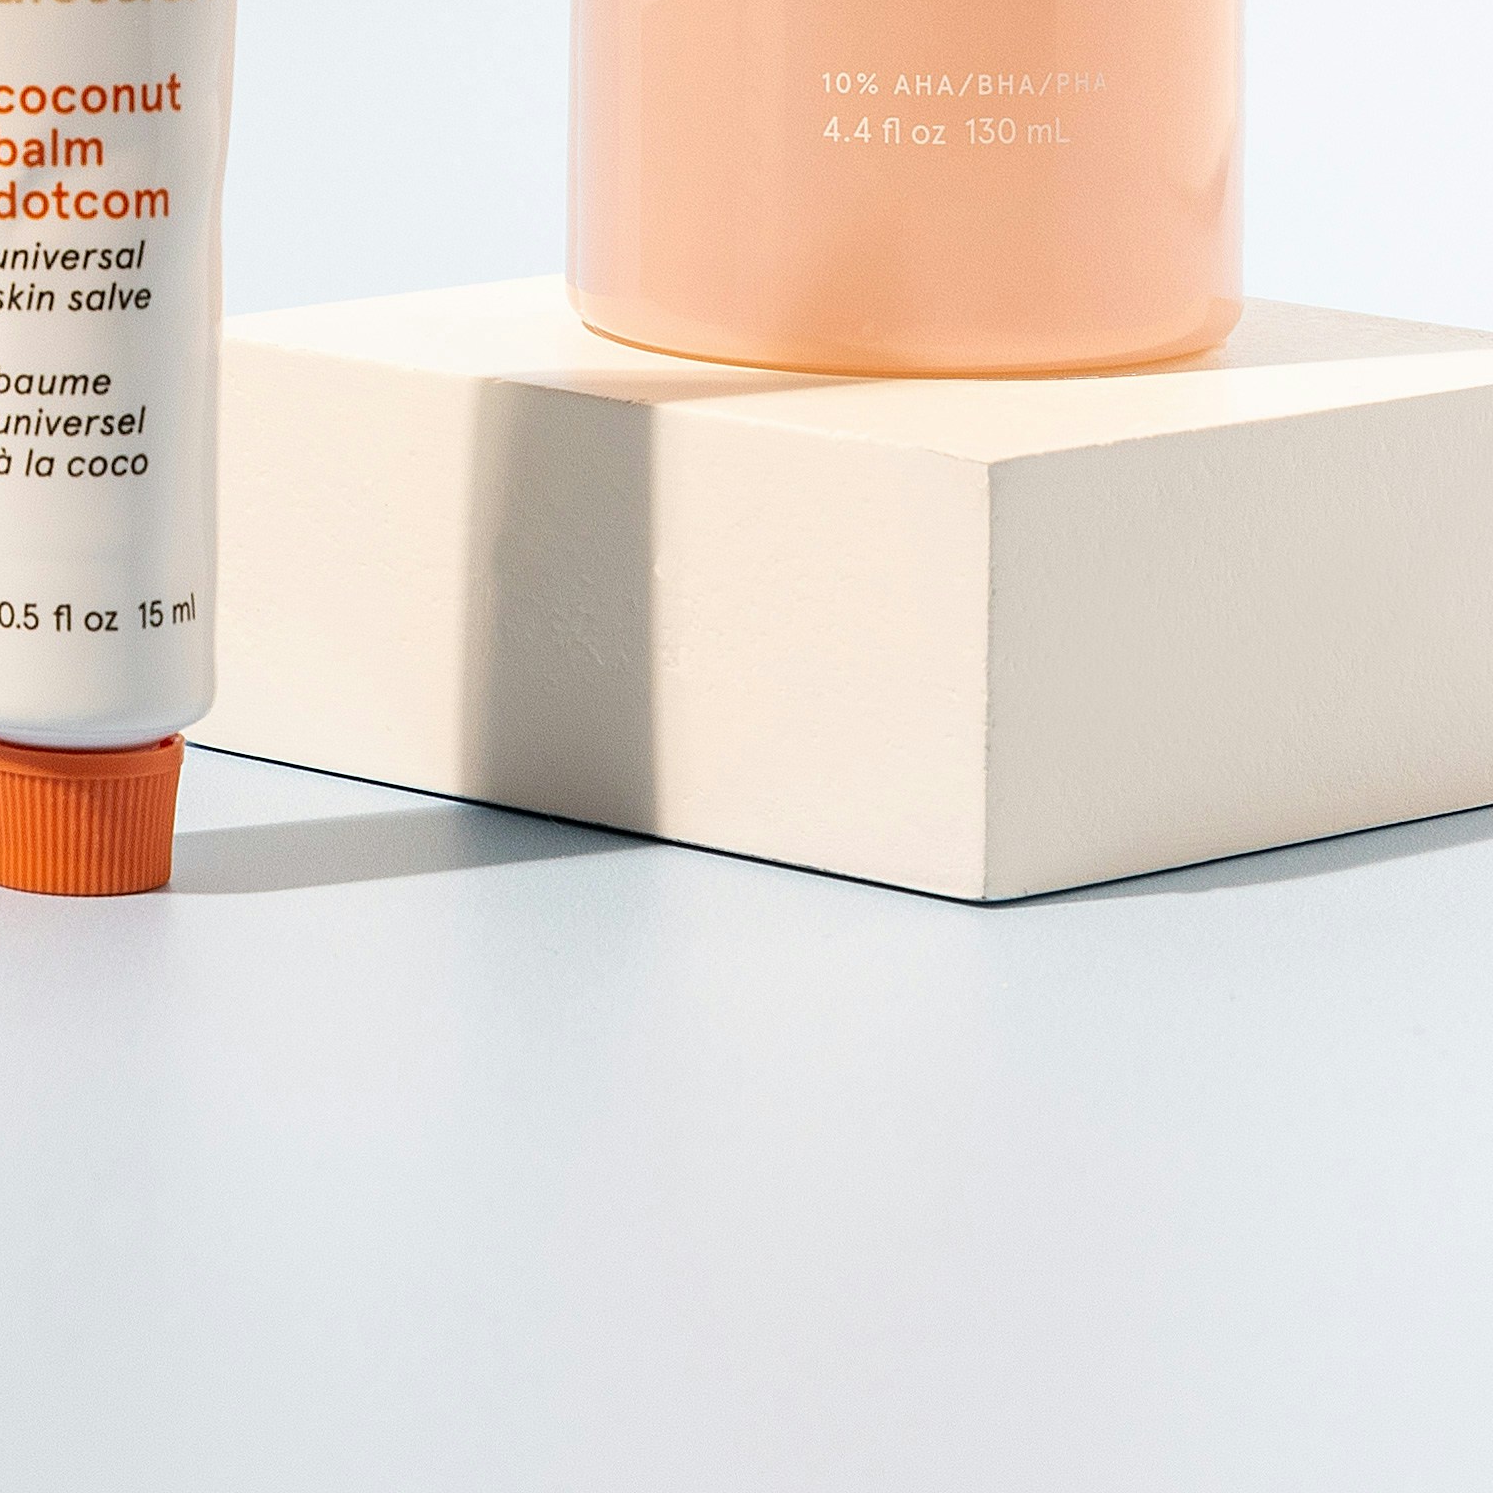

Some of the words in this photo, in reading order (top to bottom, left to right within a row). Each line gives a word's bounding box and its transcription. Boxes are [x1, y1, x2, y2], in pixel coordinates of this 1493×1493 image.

[822, 72, 879, 94] 10%
[894, 73, 1108, 97] AHA/BHA/PHA
[823, 116, 871, 143] 4.4
[882, 117, 900, 144] fl
[911, 125, 946, 145] oz
[966, 118, 1016, 144] 130
[1028, 118, 1070, 143] mL
[68, 282, 151, 312] salve
[25, 449, 55, 477] la
[67, 453, 148, 478] coco
[53, 604, 71, 631] fl
[84, 611, 118, 632] oz
[139, 600, 164, 629] 15
[173, 594, 195, 624] ml
